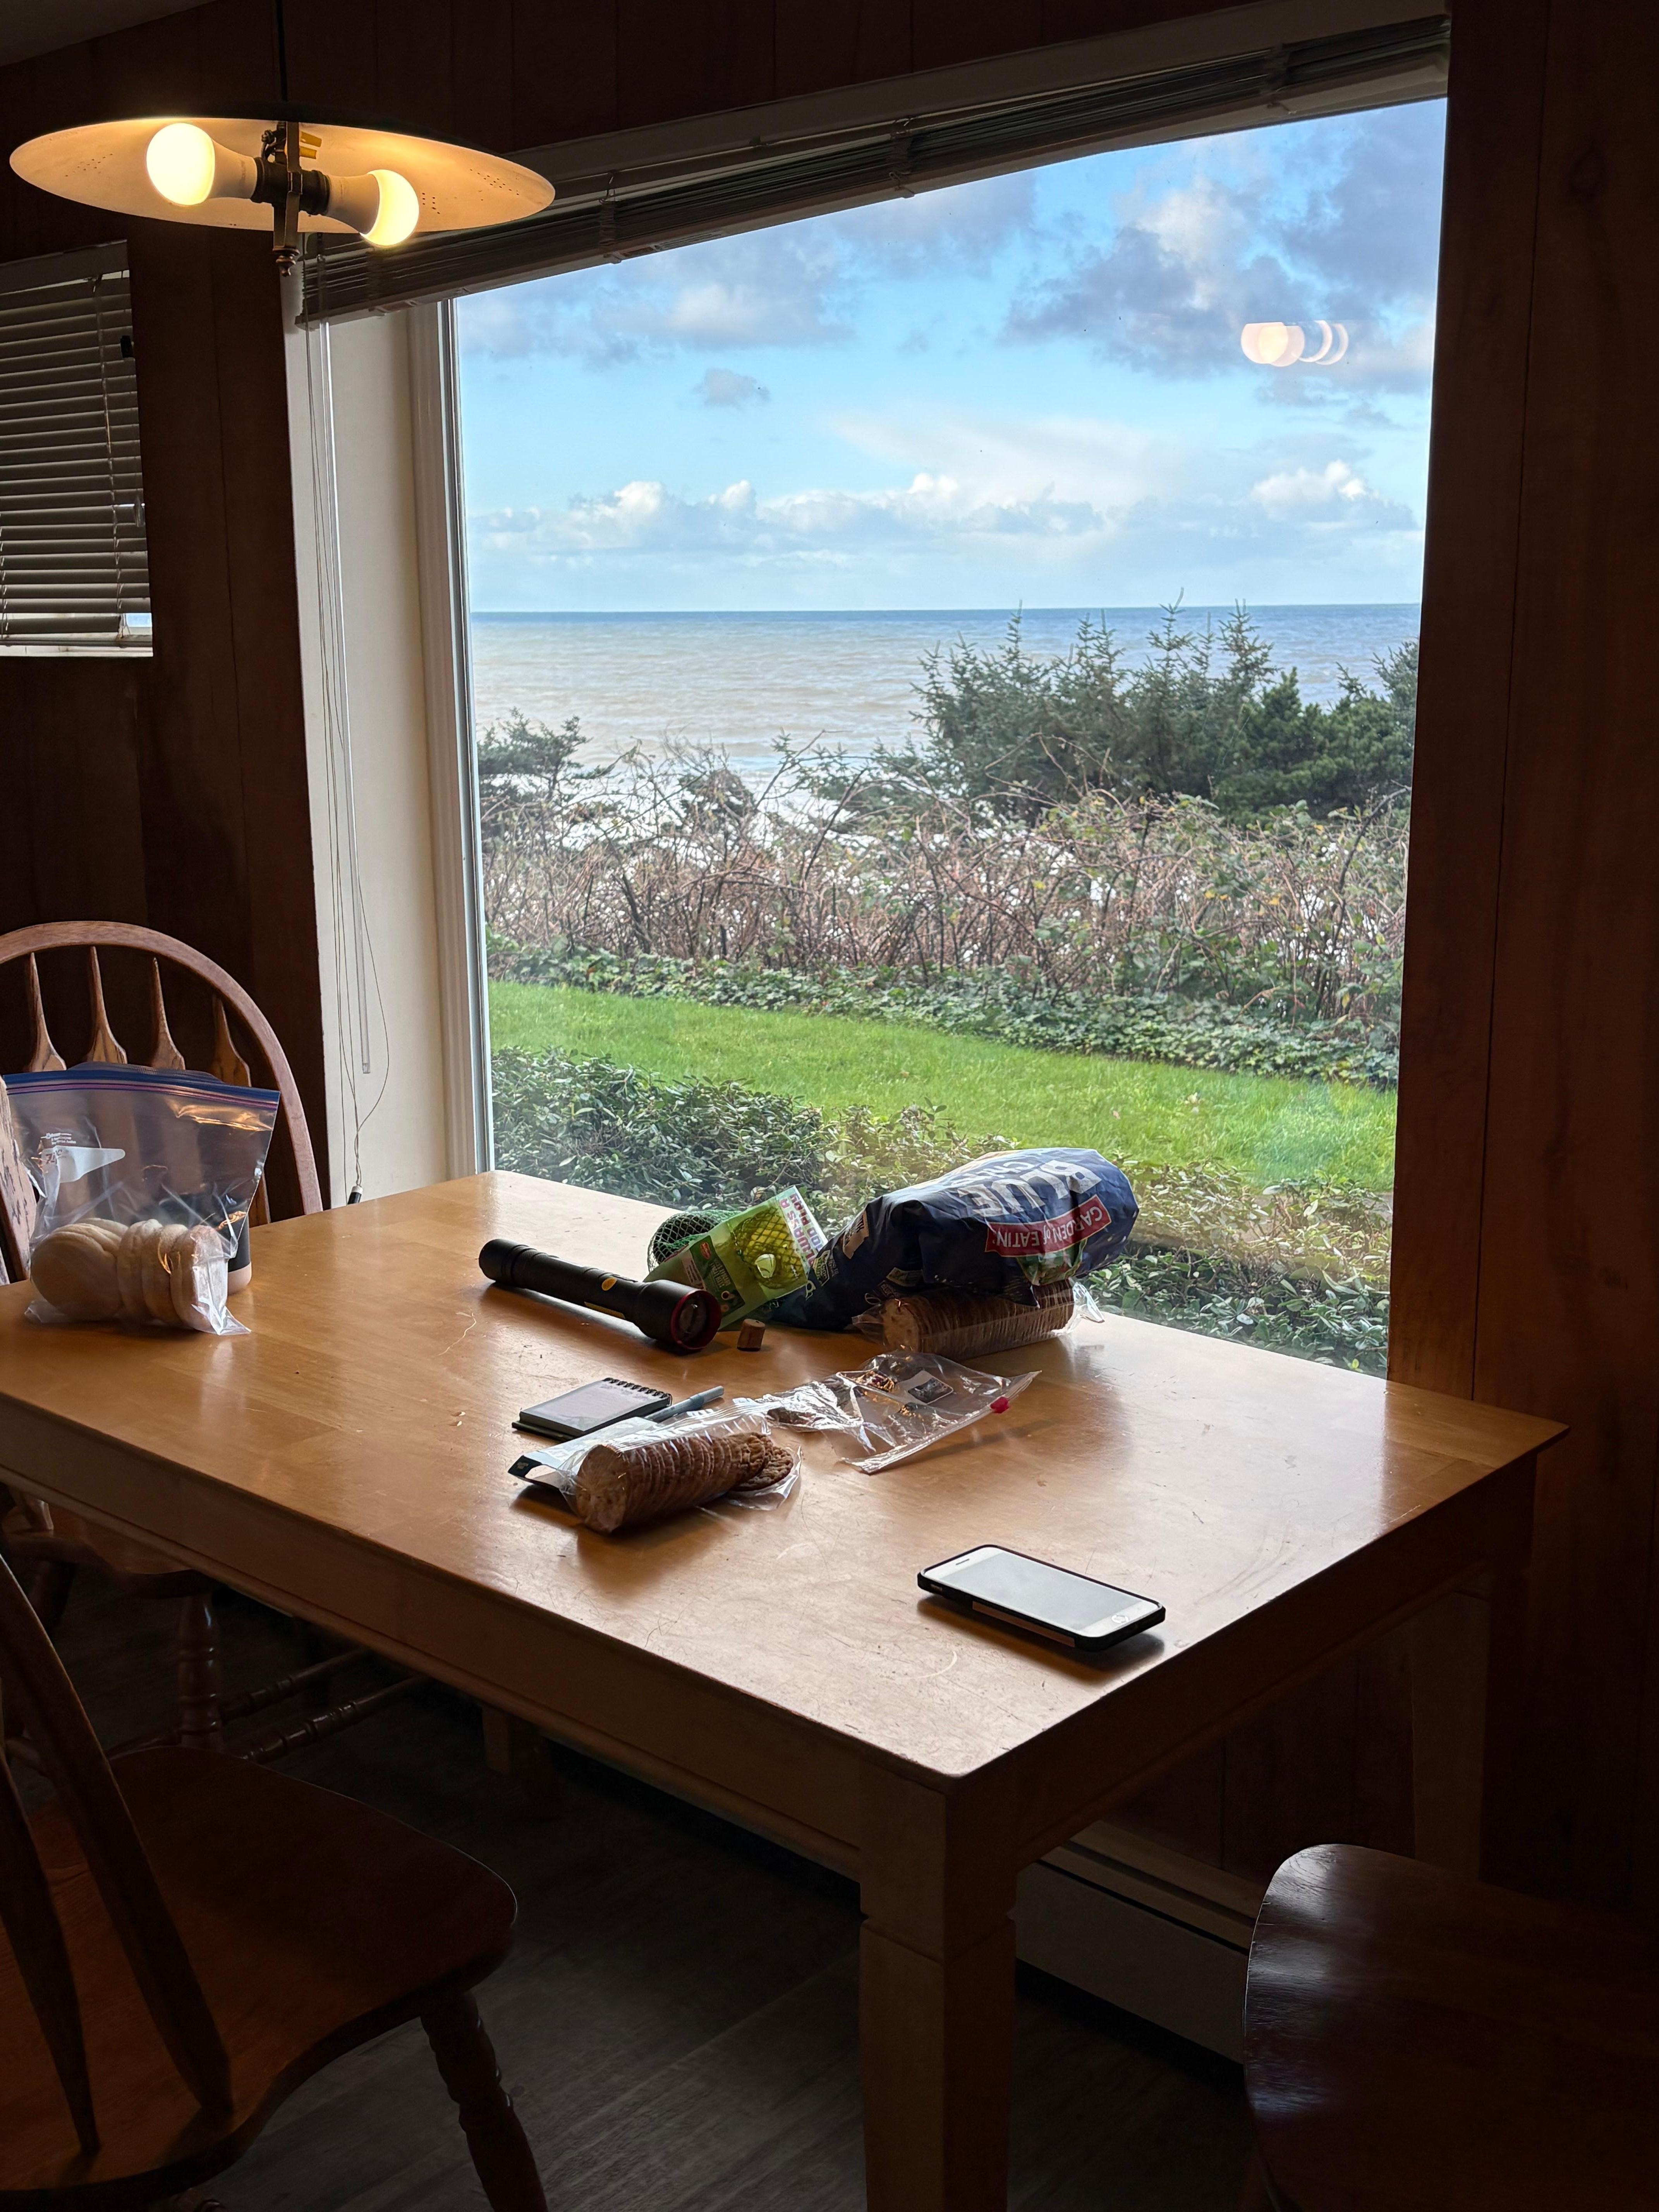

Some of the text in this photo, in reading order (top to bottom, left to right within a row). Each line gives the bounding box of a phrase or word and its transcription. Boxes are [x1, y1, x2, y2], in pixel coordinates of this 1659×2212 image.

[780, 1199, 790, 1208] A
[958, 1160, 1102, 1217] BLUE
[790, 1194, 811, 1226] PLAY
[1053, 1206, 1103, 1243] GARDEN
[1043, 1225, 1051, 1243] of
